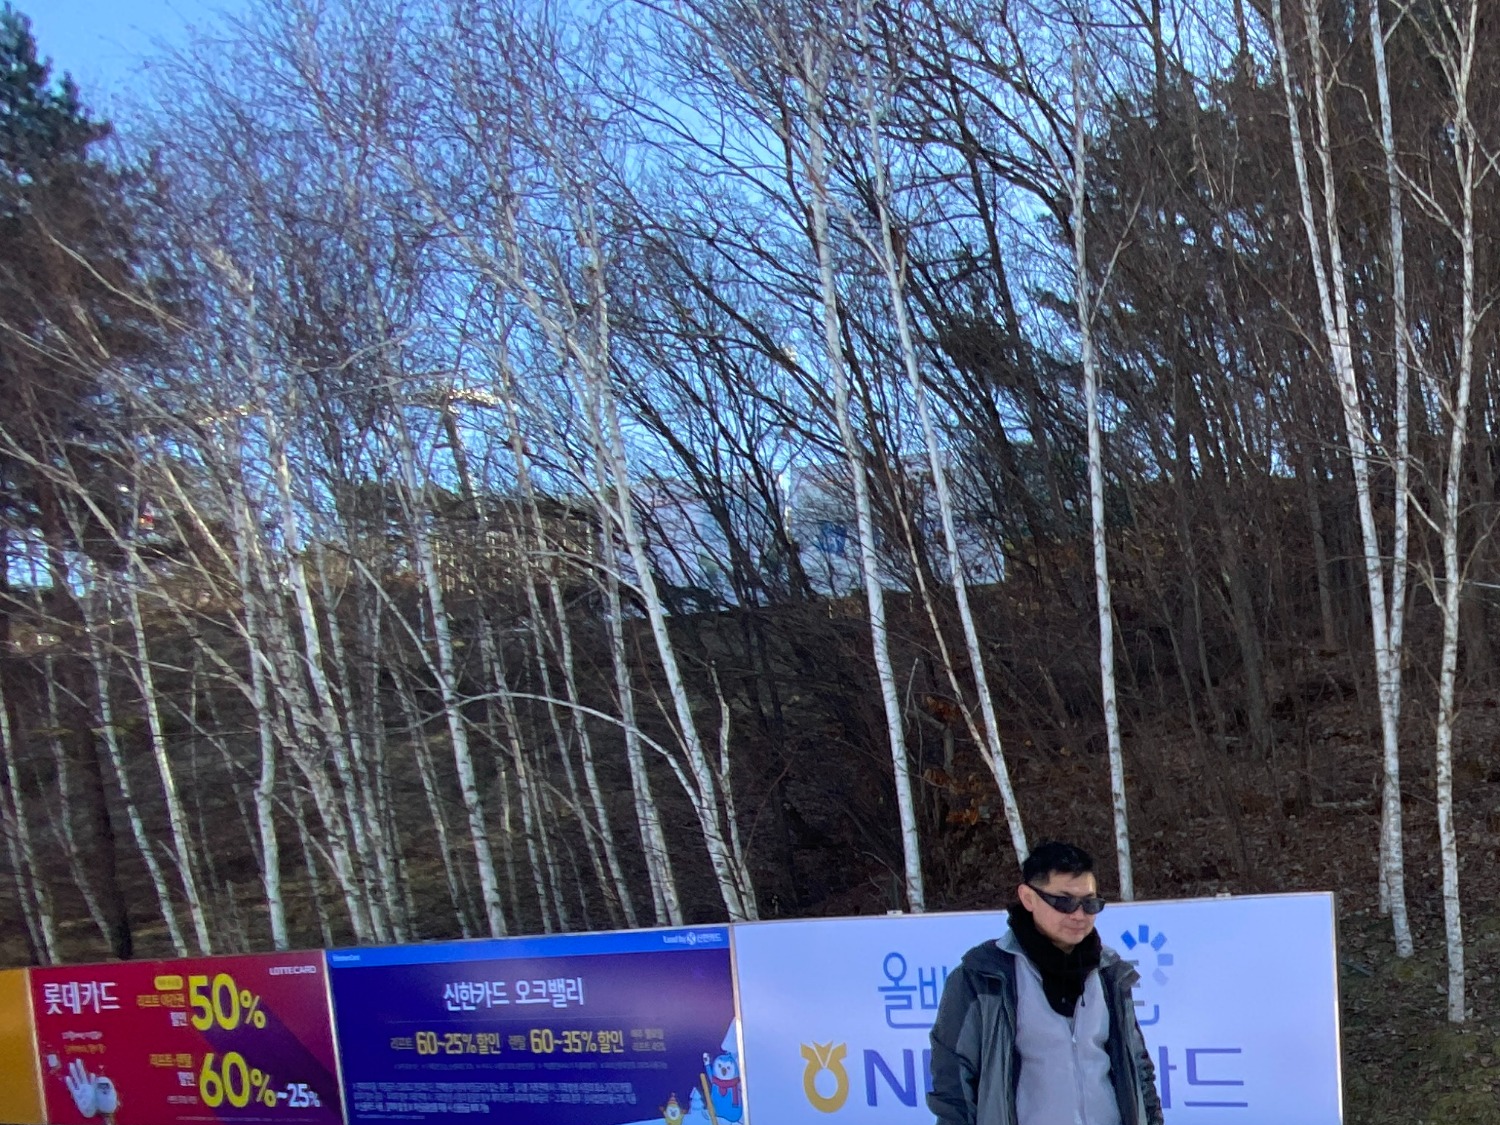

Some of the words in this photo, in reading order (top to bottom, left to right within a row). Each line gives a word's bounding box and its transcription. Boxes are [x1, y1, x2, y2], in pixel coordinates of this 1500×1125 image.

[43, 981, 120, 1014] 롯데카드
[189, 973, 266, 1030] 50%
[444, 981, 510, 1011] 신한카드
[515, 977, 584, 1008] 오크밸리
